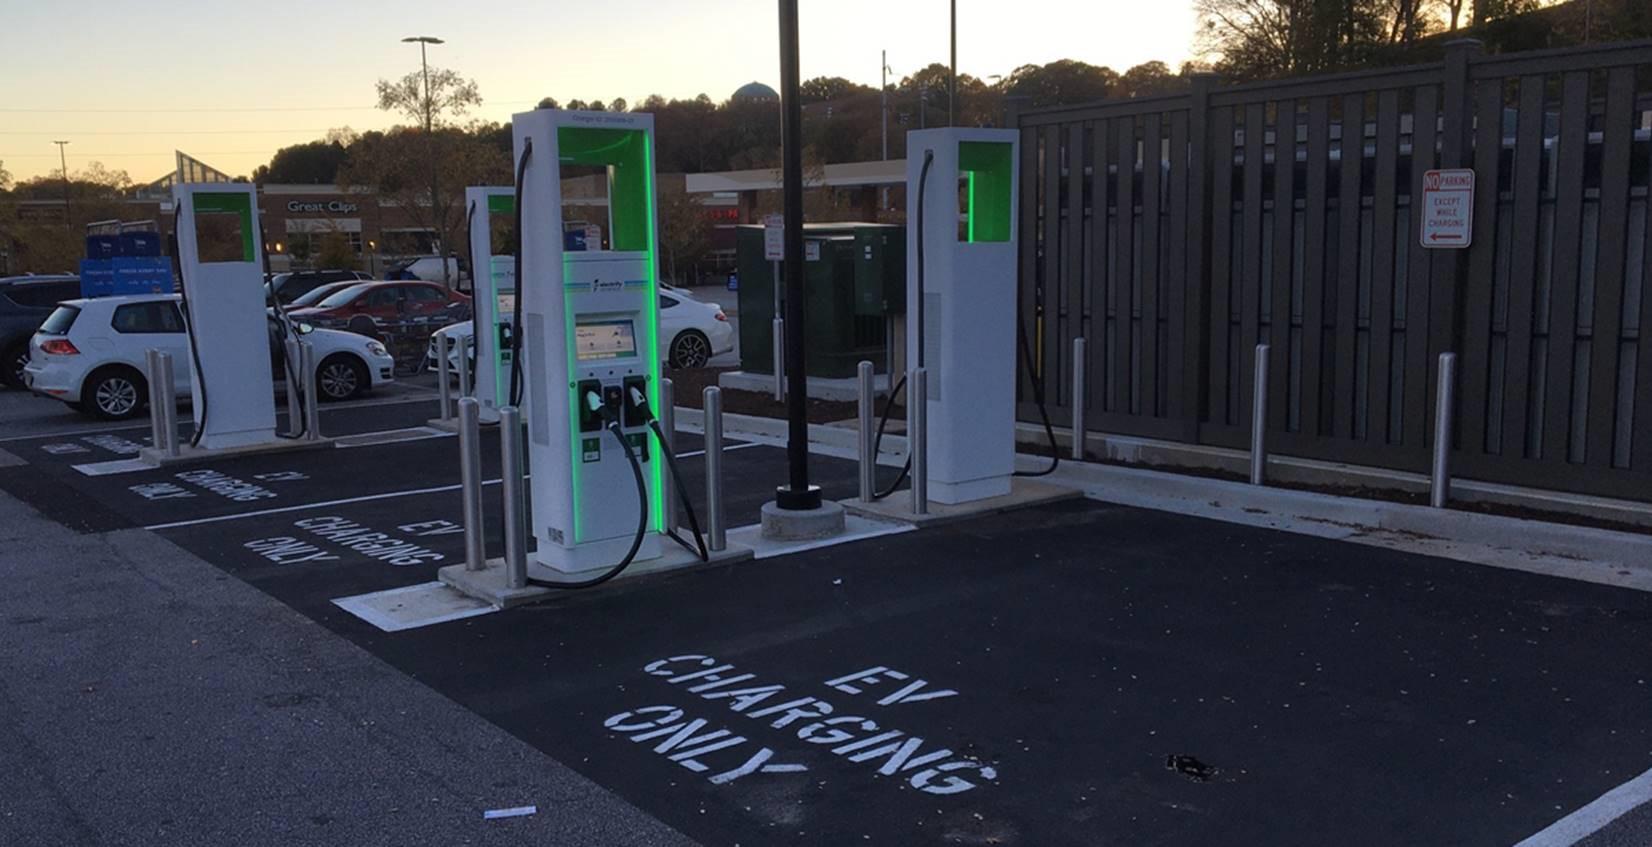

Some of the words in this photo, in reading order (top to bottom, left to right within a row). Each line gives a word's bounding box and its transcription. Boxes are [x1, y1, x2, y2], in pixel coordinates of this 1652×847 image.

[1424, 174, 1440, 190] NO
[1440, 175, 1471, 186] PARKING
[287, 200, 322, 212] Great
[328, 200, 358, 214] Clips
[1434, 197, 1461, 206] EXCEPT
[1436, 208, 1458, 216] WHILE
[1429, 218, 1464, 227] CHARGING
[397, 519, 466, 537] EV
[293, 515, 445, 567] CHARGING
[243, 536, 341, 565] ONLY
[824, 665, 960, 706] EV
[643, 654, 998, 795] CHARGING
[603, 705, 809, 785] ONLY
